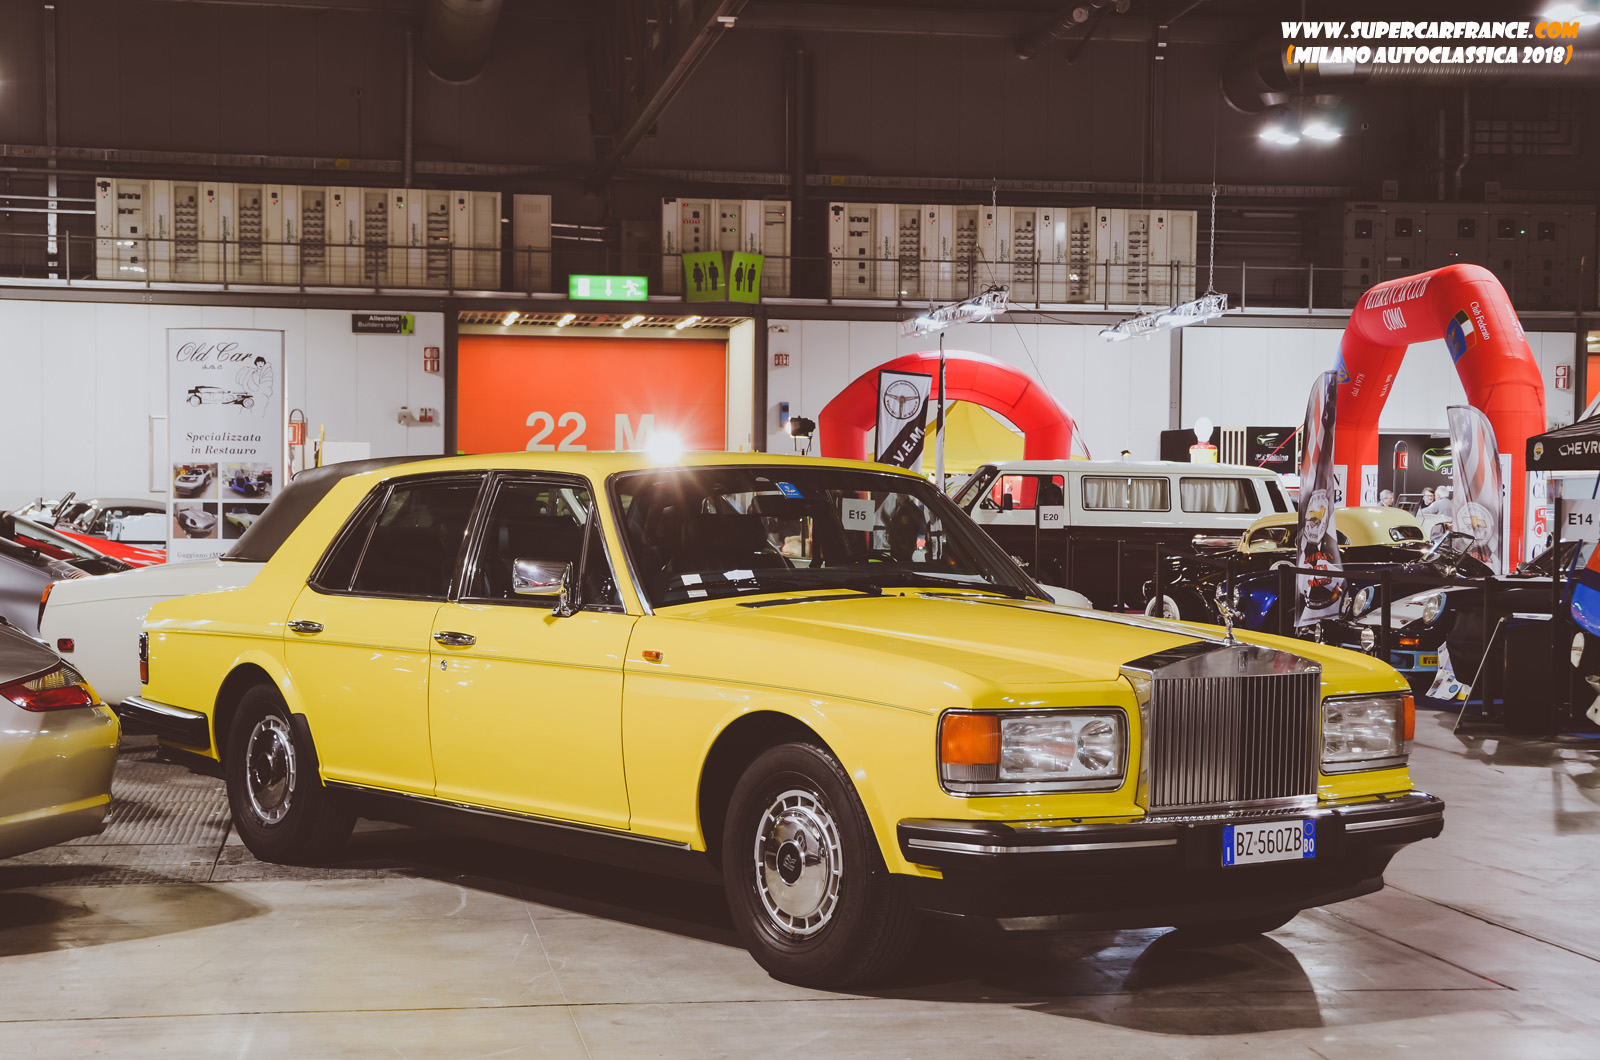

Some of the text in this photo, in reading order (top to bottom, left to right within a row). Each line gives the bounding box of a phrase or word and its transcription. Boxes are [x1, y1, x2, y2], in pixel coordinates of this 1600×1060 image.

[1407, 277, 1431, 300] CLUB
[1382, 307, 1407, 331] COMO
[176, 342, 252, 362] Old Car
[186, 432, 261, 443] Specializzata
[525, 411, 587, 451] 22
[191, 445, 257, 455] in Restauro
[1559, 440, 1600, 456] CHEVR
[849, 510, 866, 521] E15
[1043, 513, 1059, 521] E20
[1568, 513, 1593, 525] E14
[1236, 831, 1254, 857] BZ
[1258, 827, 1302, 854] 560ZB
[1303, 838, 1315, 853] BO
